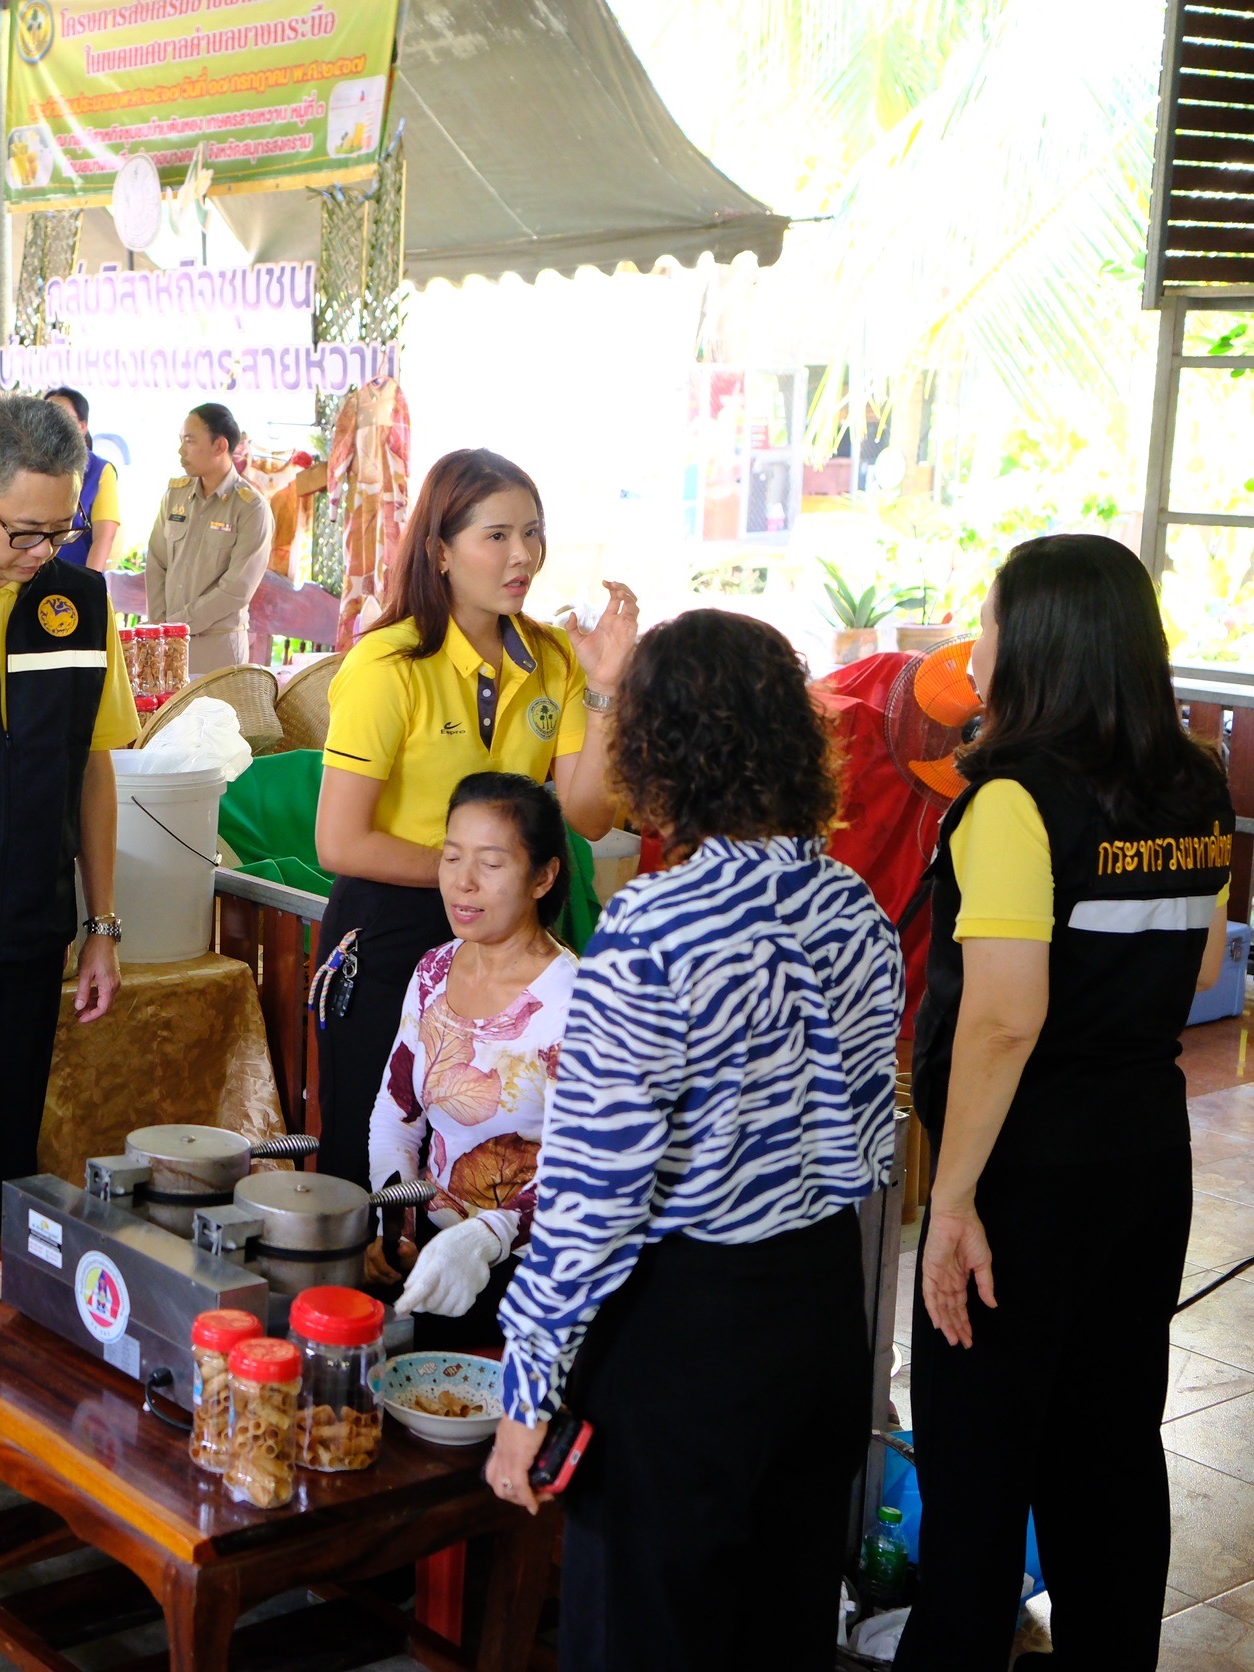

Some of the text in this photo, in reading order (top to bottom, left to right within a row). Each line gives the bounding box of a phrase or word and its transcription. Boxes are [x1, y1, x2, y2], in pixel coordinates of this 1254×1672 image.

[230, 67, 289, 94] กรกฎาคม
[47, 260, 314, 331] กลุ่มวิสาหกิจชุมชน
